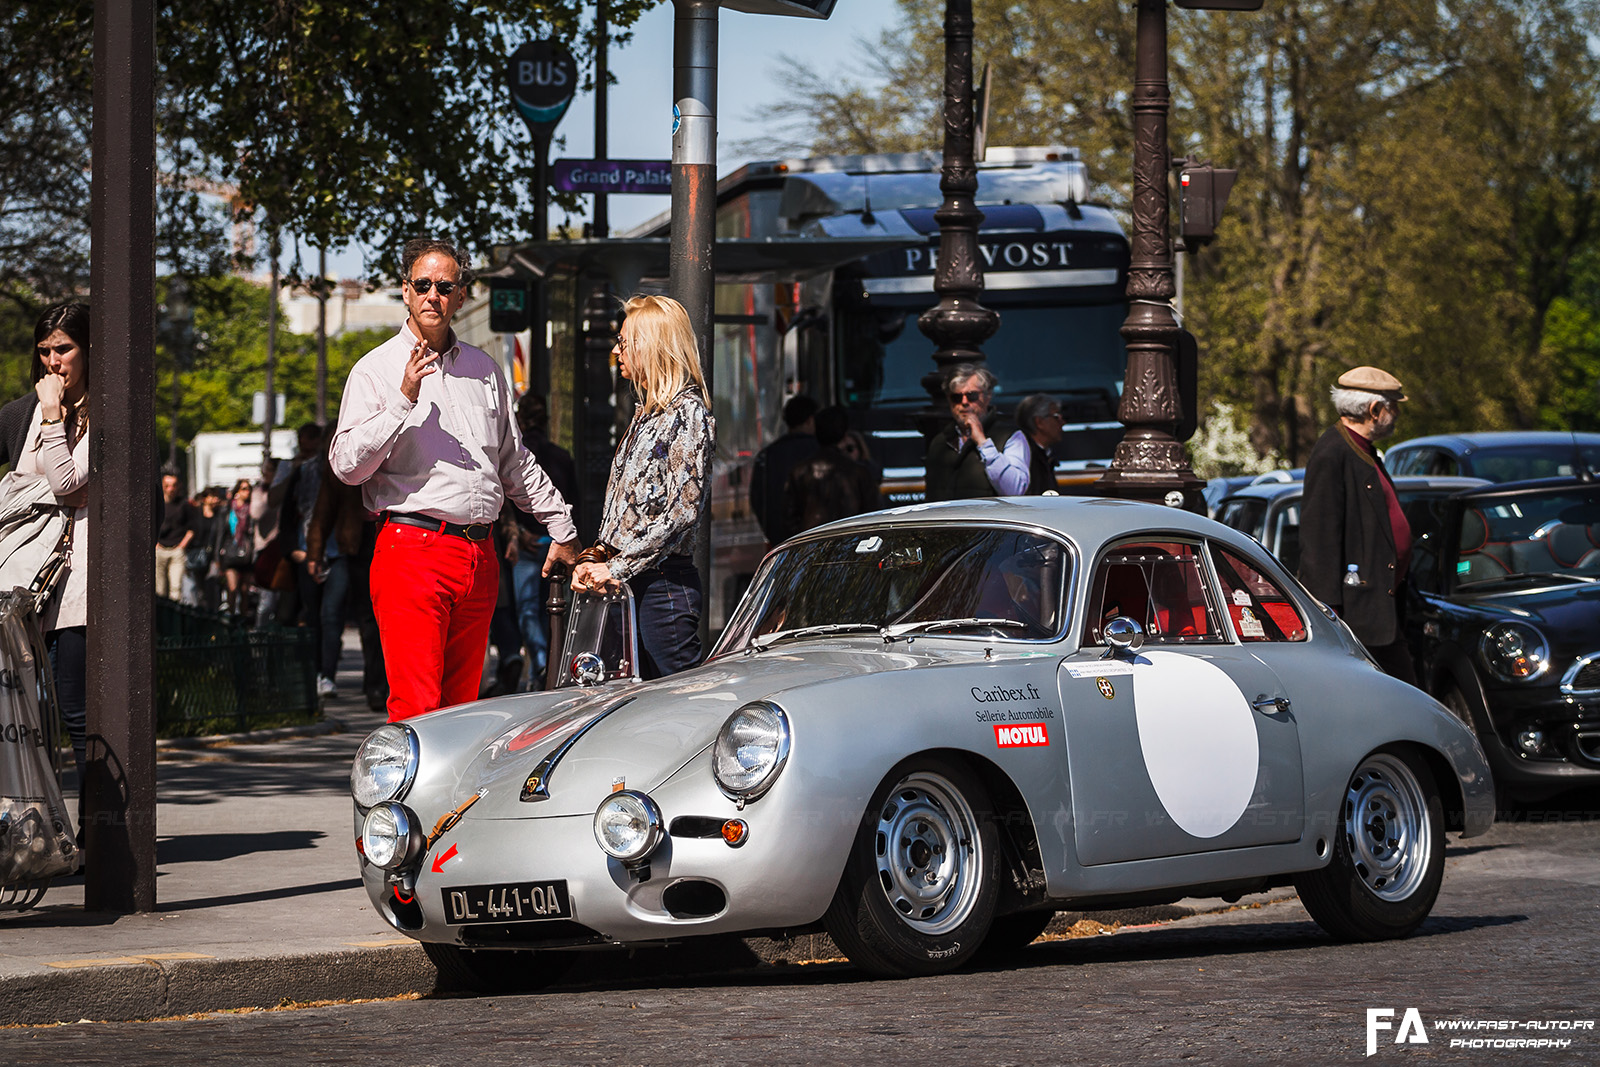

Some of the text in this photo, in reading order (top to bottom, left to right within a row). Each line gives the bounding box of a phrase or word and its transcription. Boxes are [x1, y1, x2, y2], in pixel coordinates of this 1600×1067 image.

[518, 61, 567, 86] BUS
[570, 168, 672, 185] Grand Palais
[906, 242, 1073, 271] PVOST
[970, 683, 1041, 703] Caribex.fr
[975, 706, 1055, 723] Sellerie Automobile
[998, 726, 1046, 745] MOTUL
[450, 885, 561, 920] DL-441-QA
